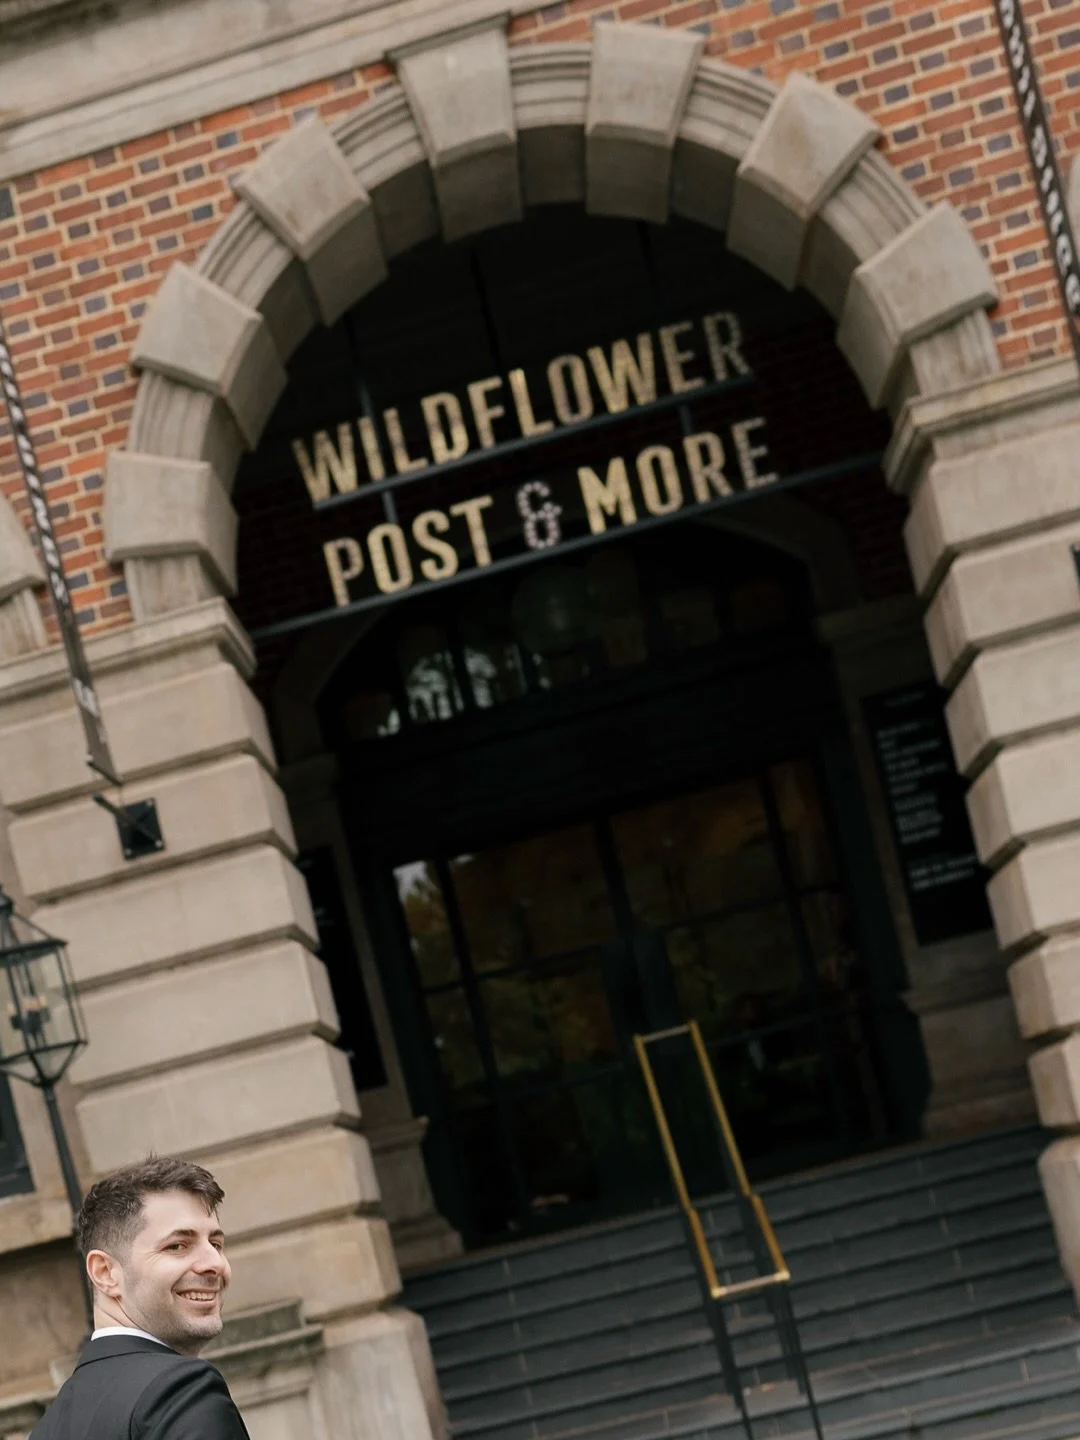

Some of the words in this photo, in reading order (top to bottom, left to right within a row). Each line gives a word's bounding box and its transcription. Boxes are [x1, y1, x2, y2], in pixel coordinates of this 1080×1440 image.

[292, 311, 749, 503] WILDFLOWER
[323, 495, 493, 606] POST
[517, 481, 562, 549] &
[578, 417, 779, 535] MORE
